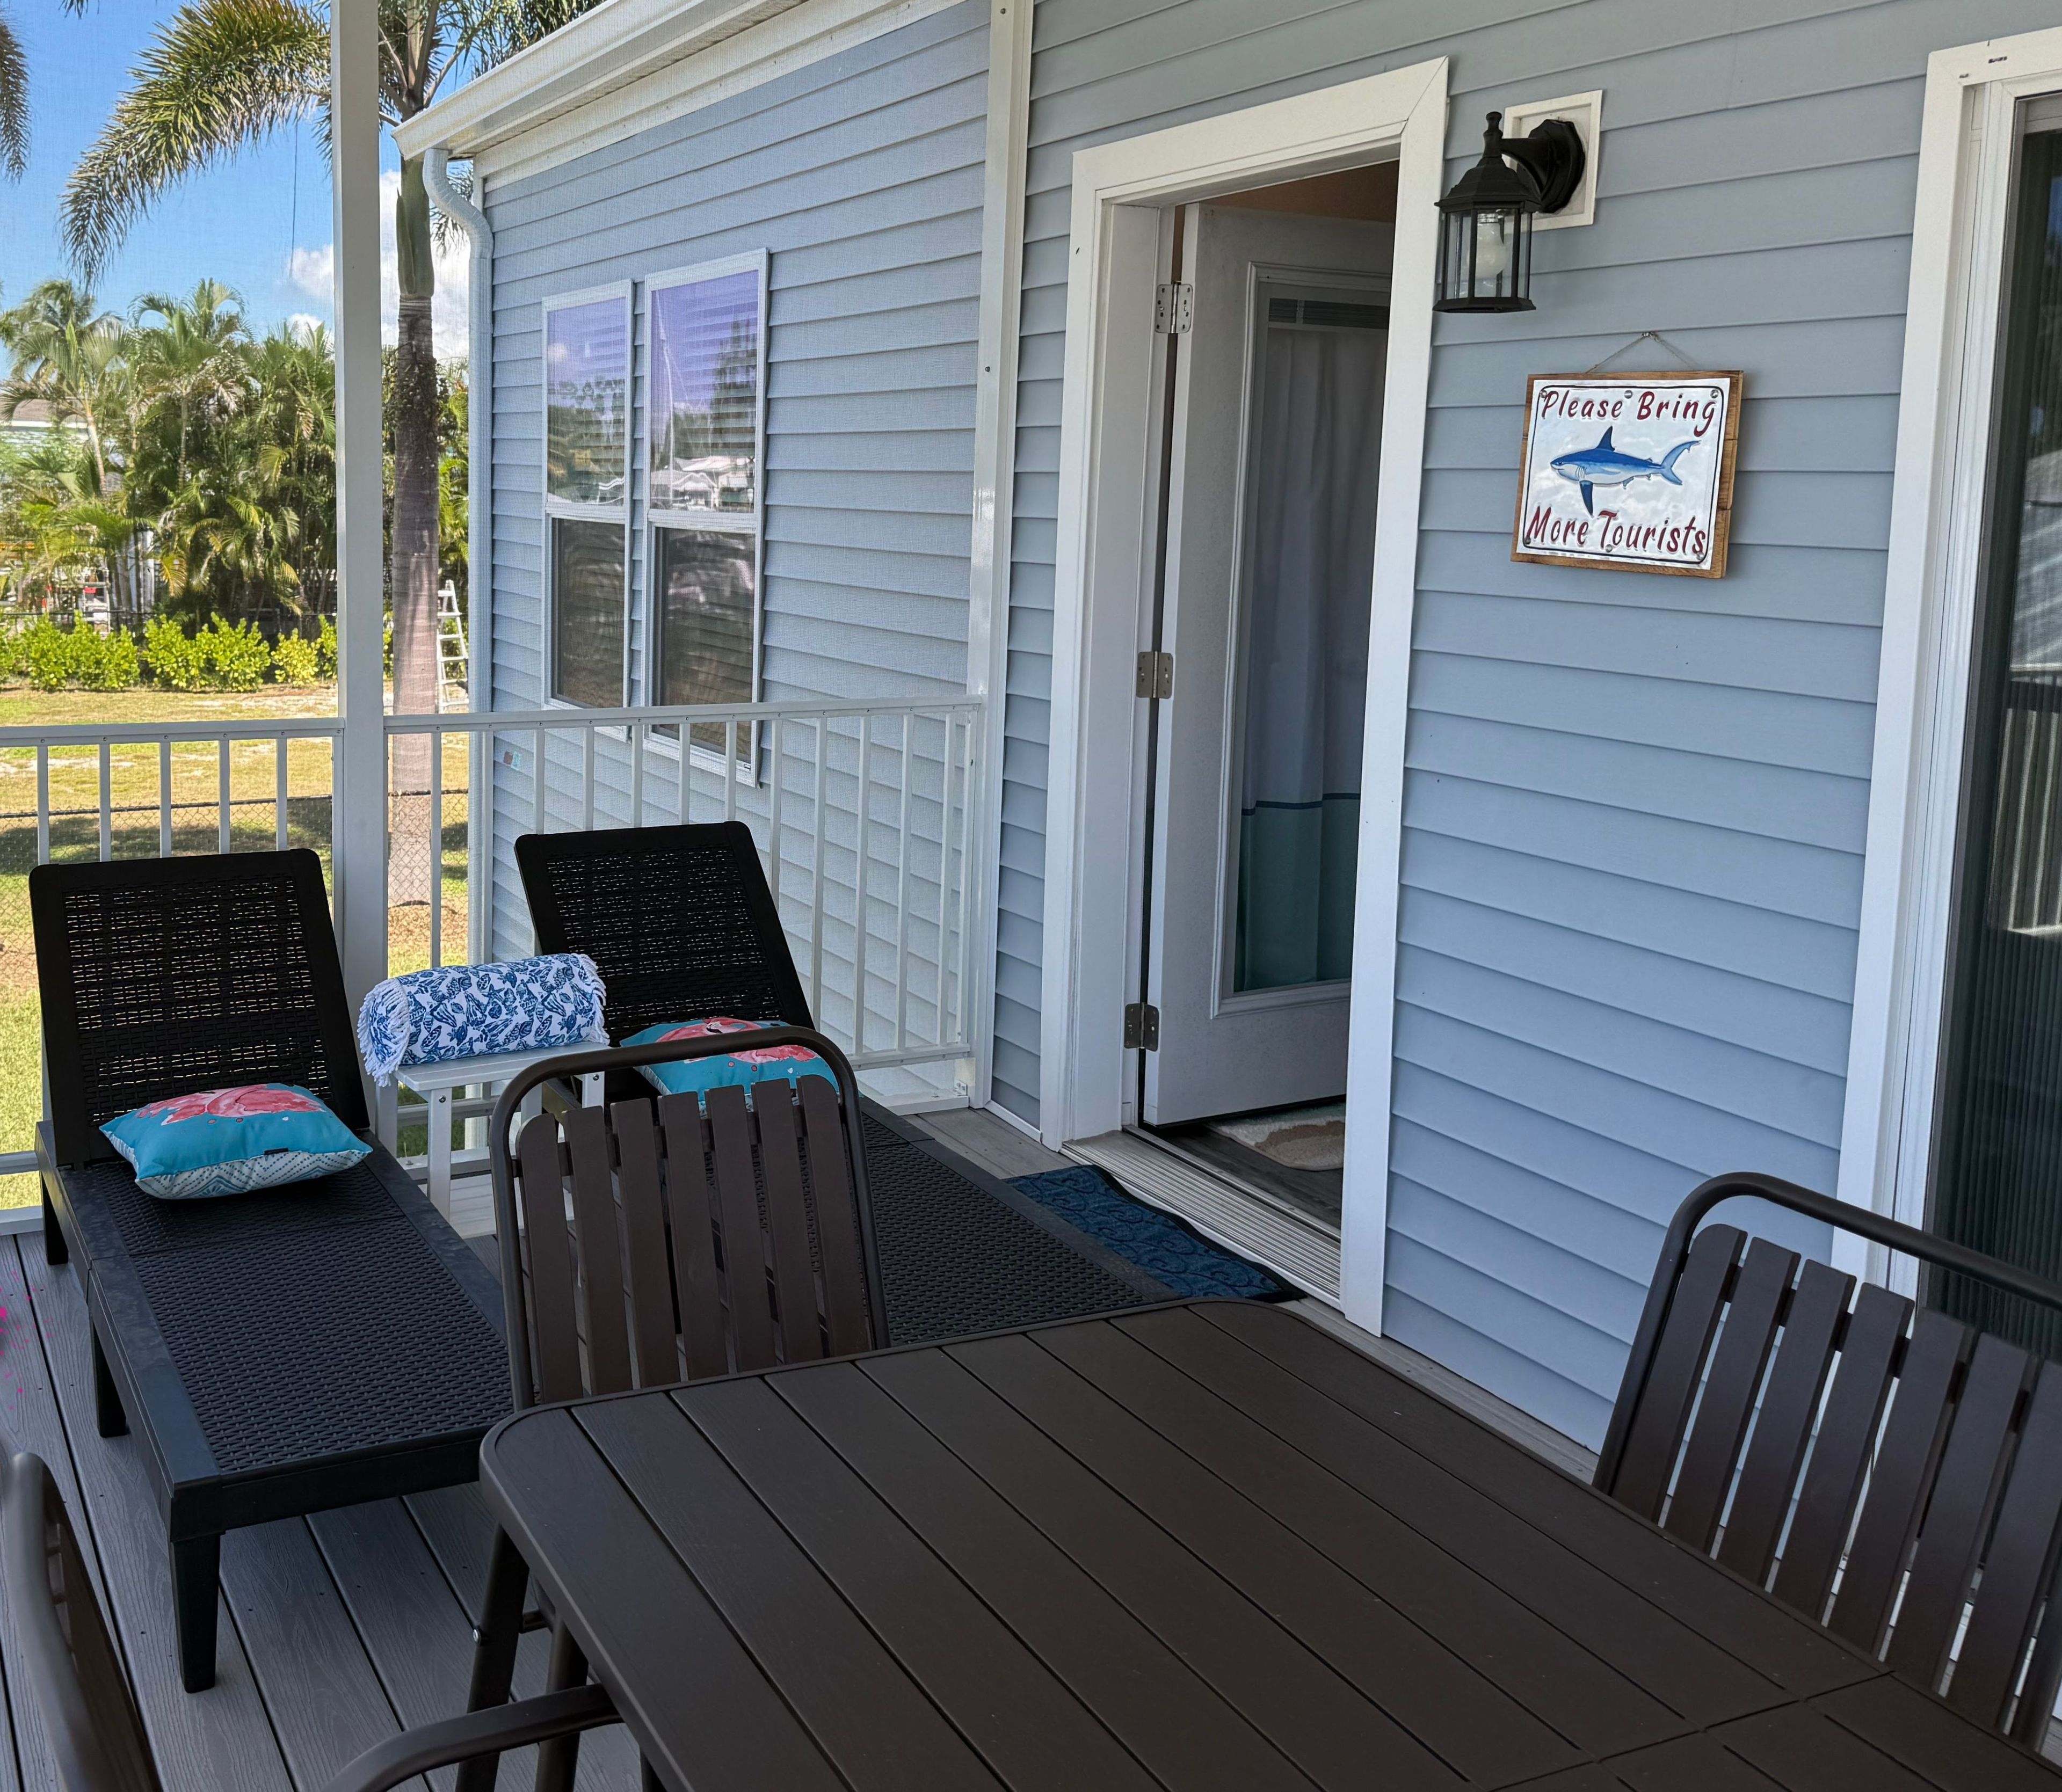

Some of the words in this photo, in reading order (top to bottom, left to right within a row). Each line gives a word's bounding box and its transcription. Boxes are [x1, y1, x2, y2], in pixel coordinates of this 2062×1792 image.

[1541, 390, 1623, 420] Please
[1637, 391, 1716, 436] Bring
[1527, 506, 1589, 545] More
[1598, 510, 1707, 555] Tourists
